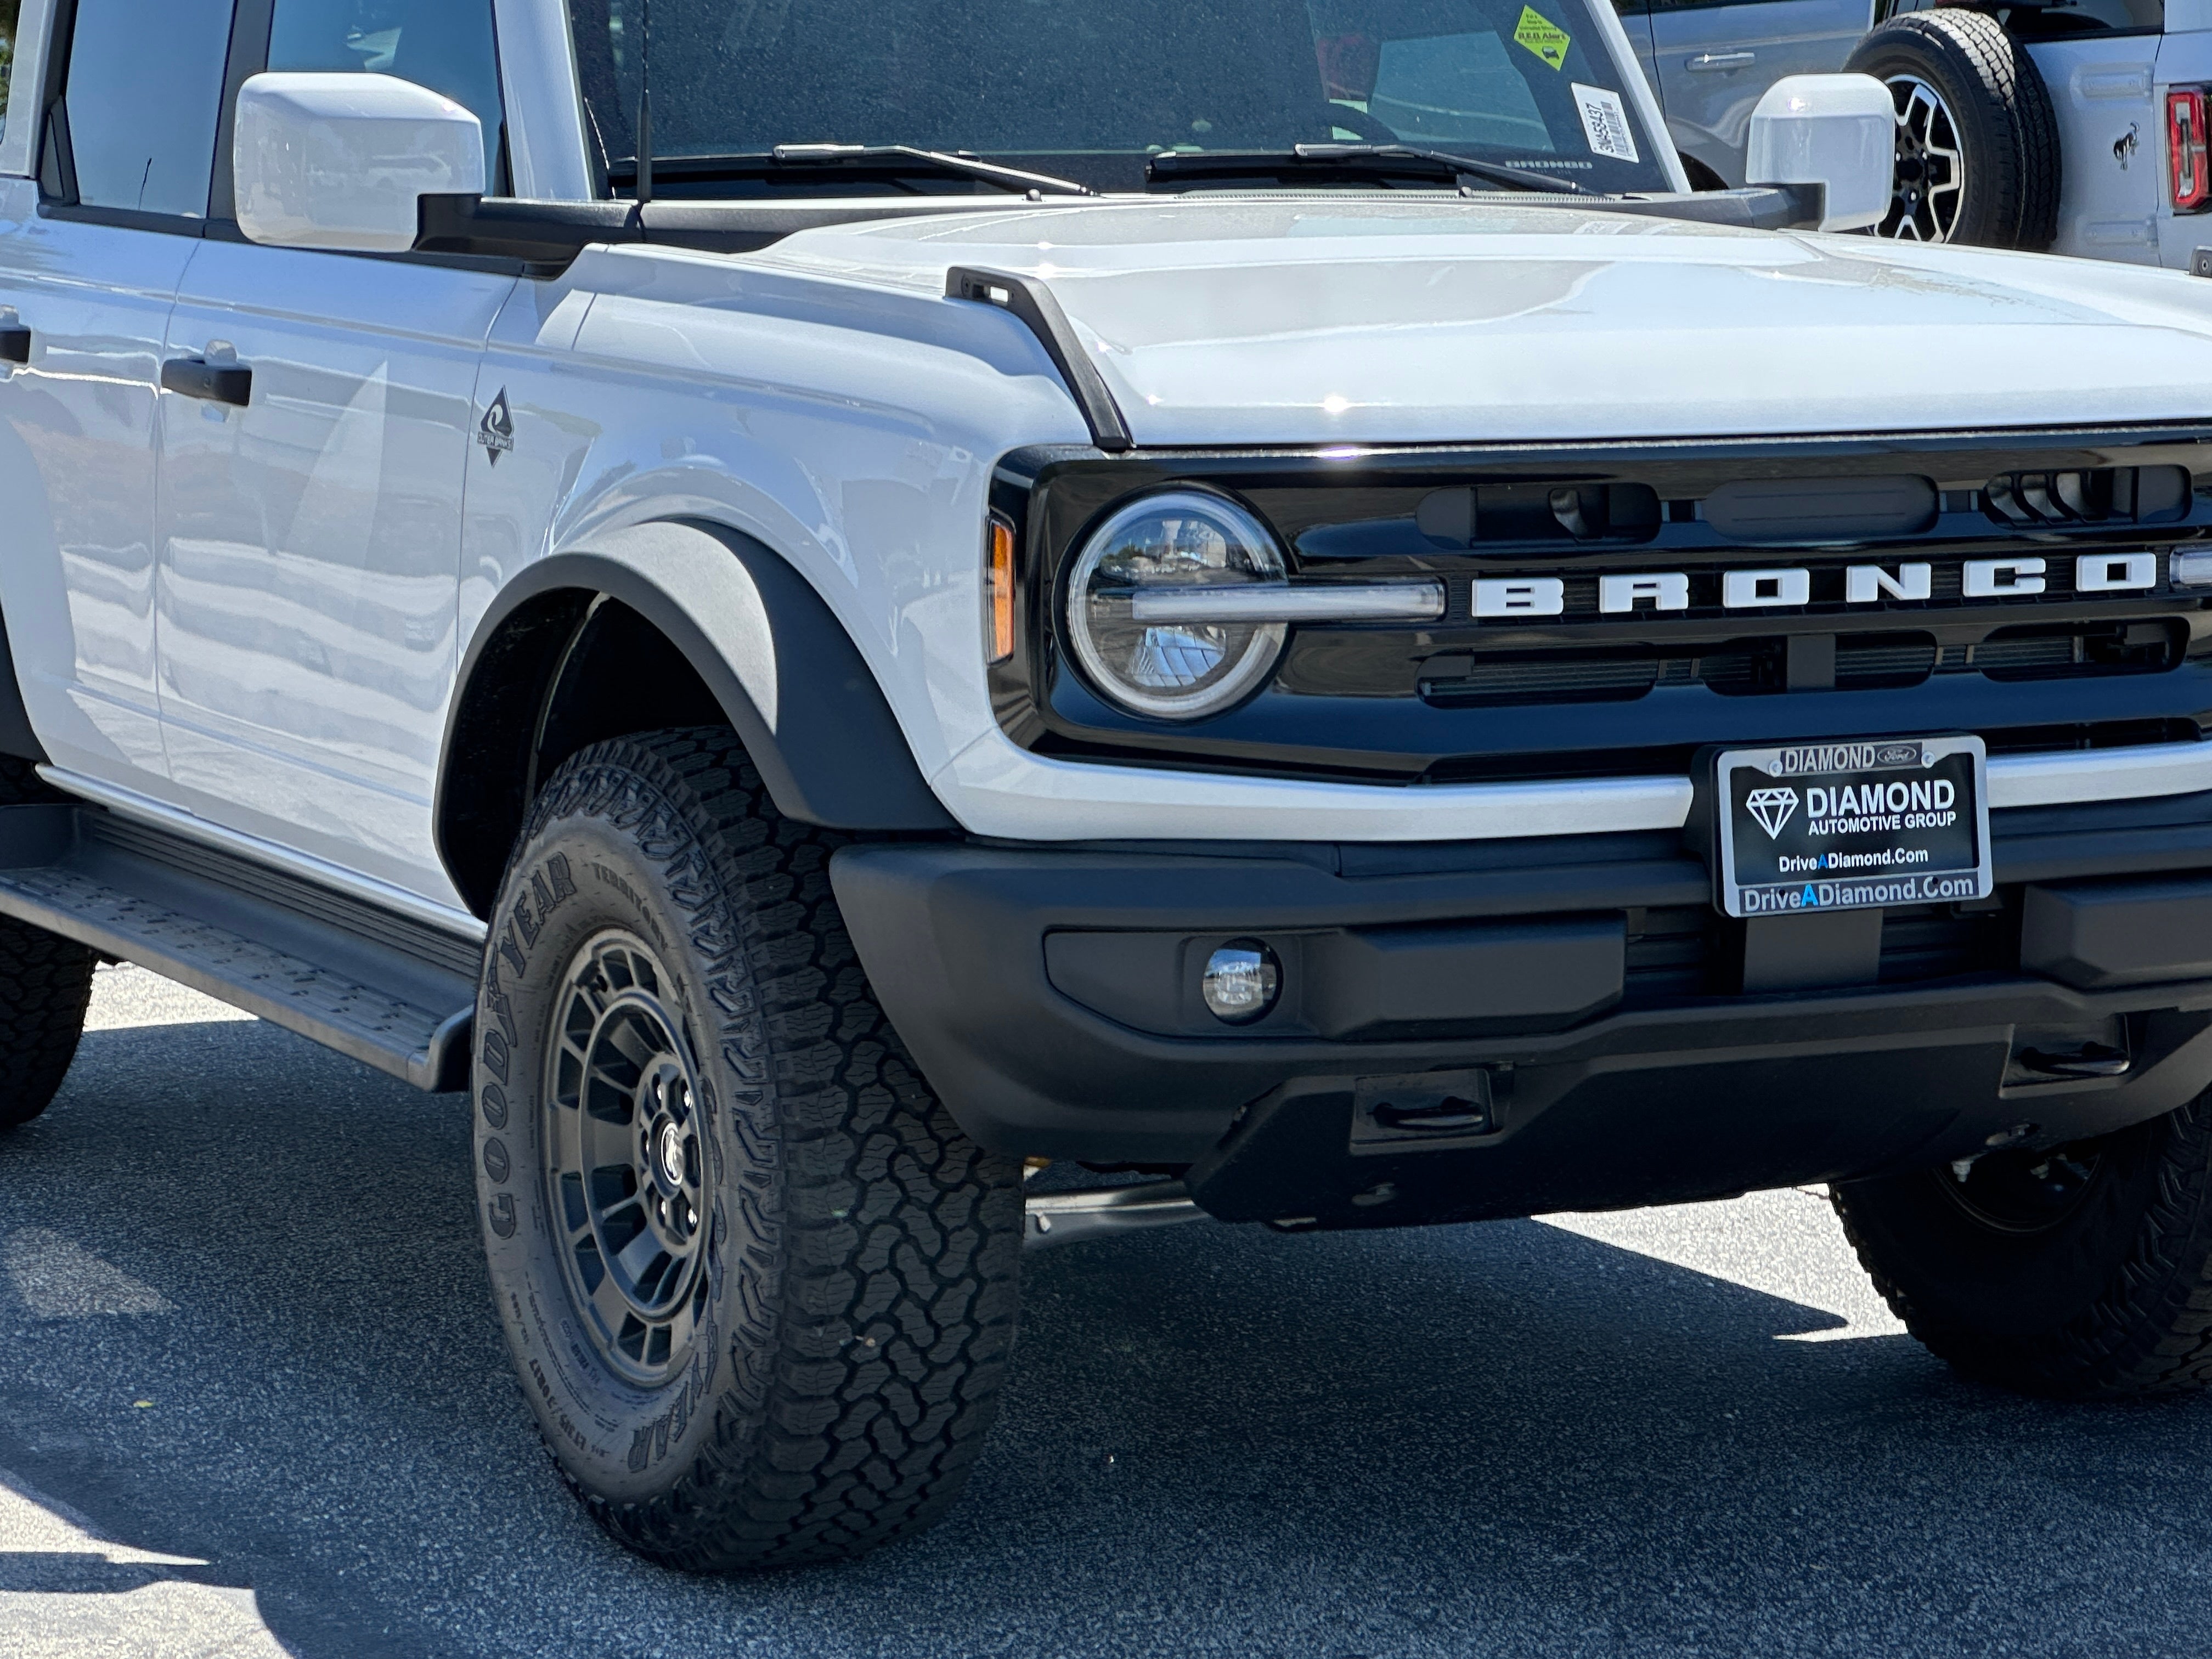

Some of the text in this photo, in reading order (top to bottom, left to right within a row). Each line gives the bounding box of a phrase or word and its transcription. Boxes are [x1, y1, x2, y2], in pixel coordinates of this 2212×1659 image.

[1472, 552, 2157, 618] BRONCO
[1785, 745, 1875, 772] DIAMOND
[1807, 779, 1955, 818] DIAMOND
[1808, 811, 1956, 836] AUTOMOTIVE GROUP
[1779, 847, 1929, 873] DriveADiamond.Com
[1745, 876, 1974, 912] DriveADiamond.Com
[482, 851, 578, 1239] GOODYEAR
